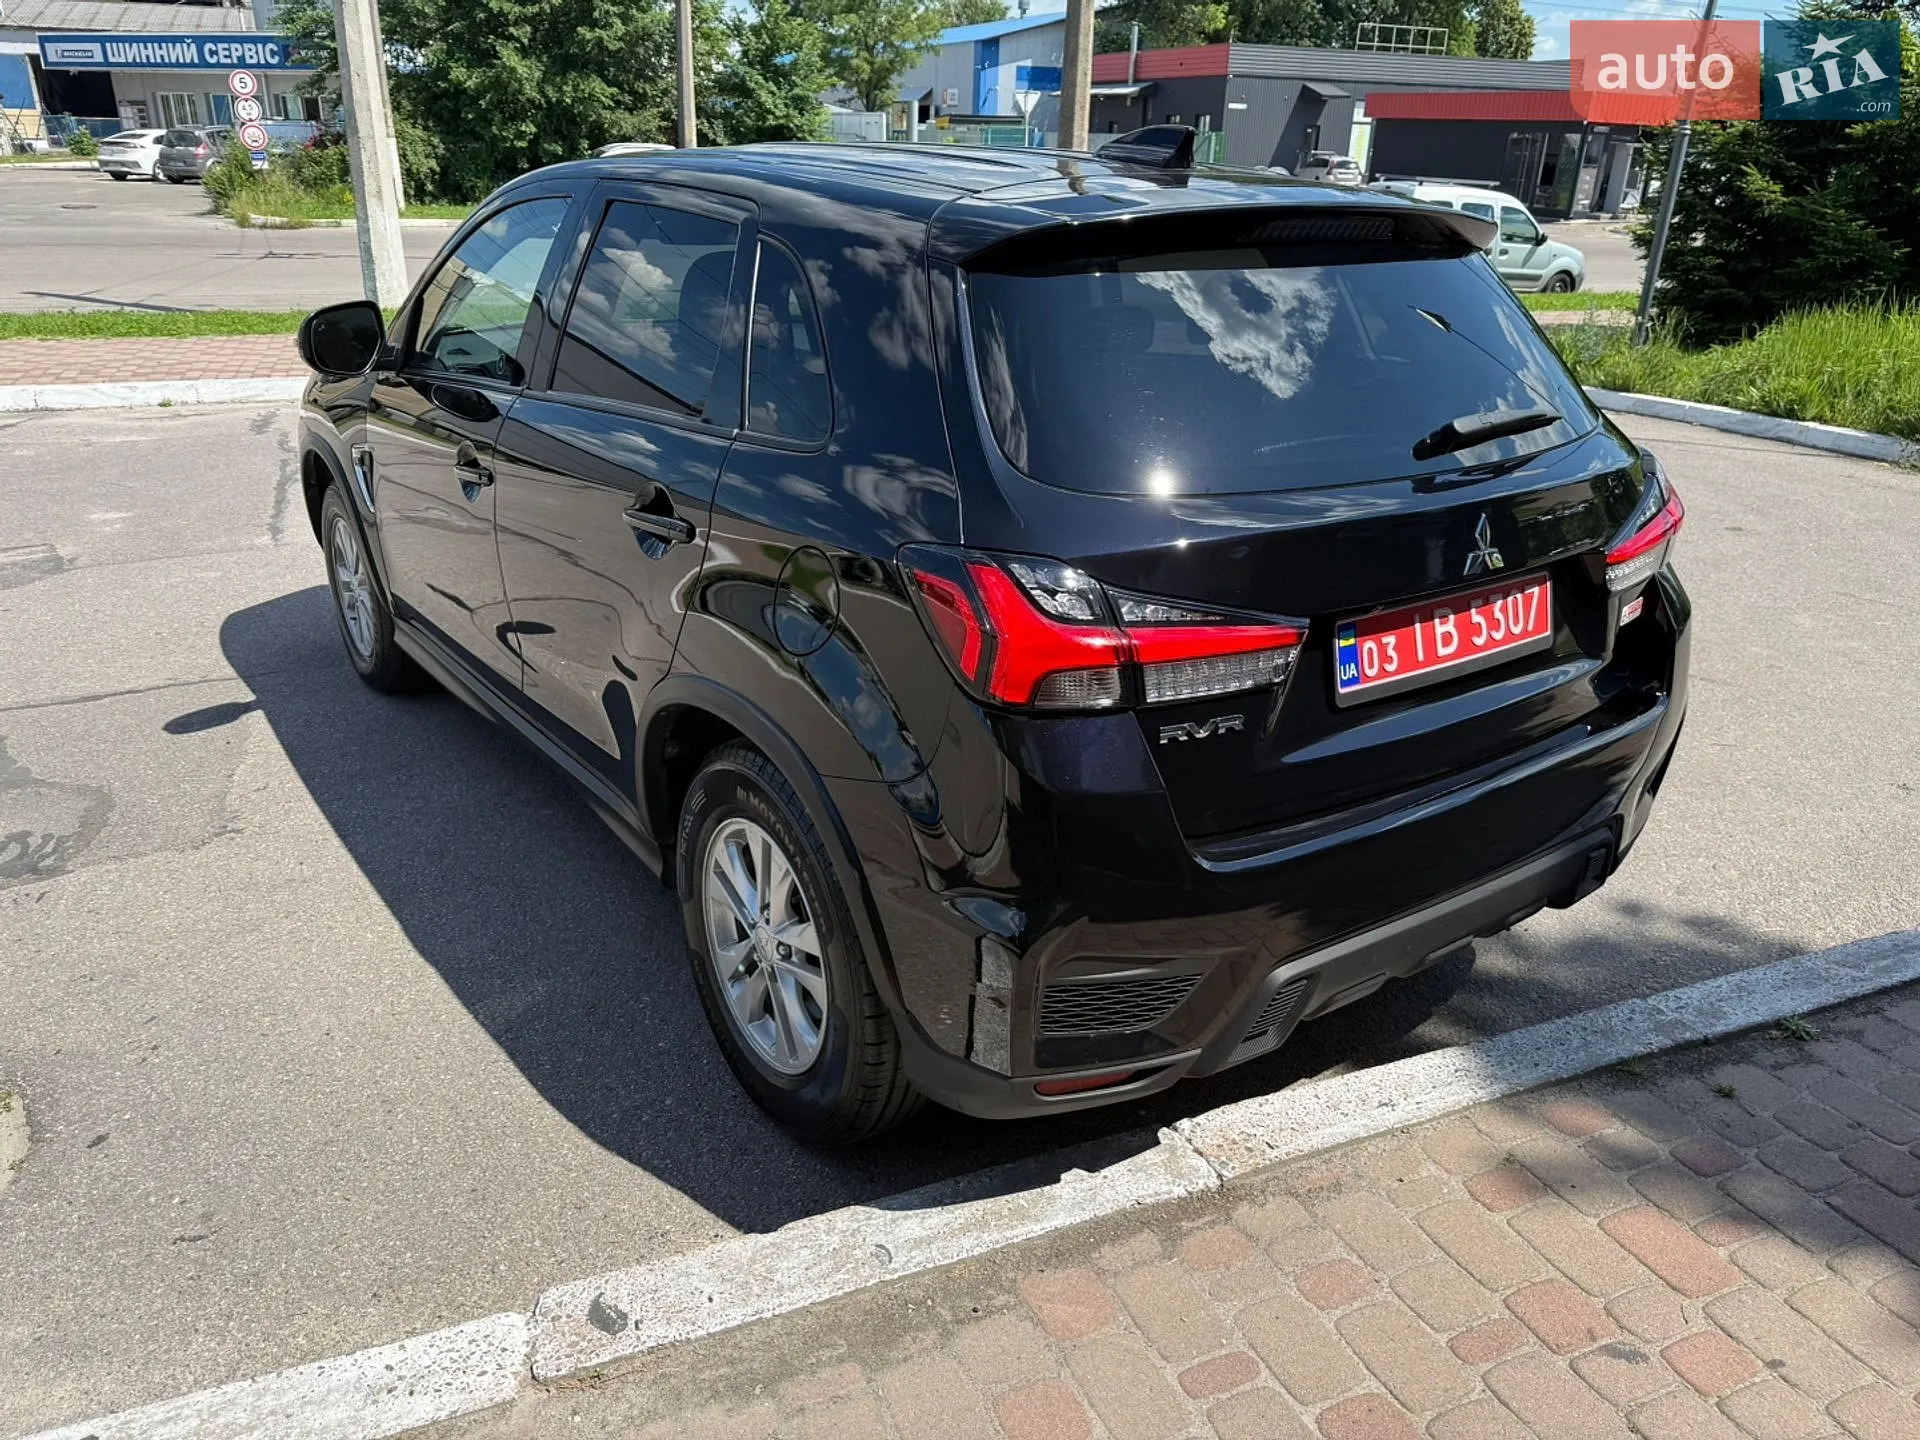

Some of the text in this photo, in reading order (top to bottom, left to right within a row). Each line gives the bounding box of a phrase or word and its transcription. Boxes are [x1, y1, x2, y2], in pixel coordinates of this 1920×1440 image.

[106, 38, 280, 64] ШИННИЙ СЕРВІС
[239, 77, 248, 89] 5
[1361, 634, 1399, 677] 03
[1469, 583, 1541, 647] 5307
[1340, 662, 1358, 681] UA
[1159, 713, 1245, 744] RVR
